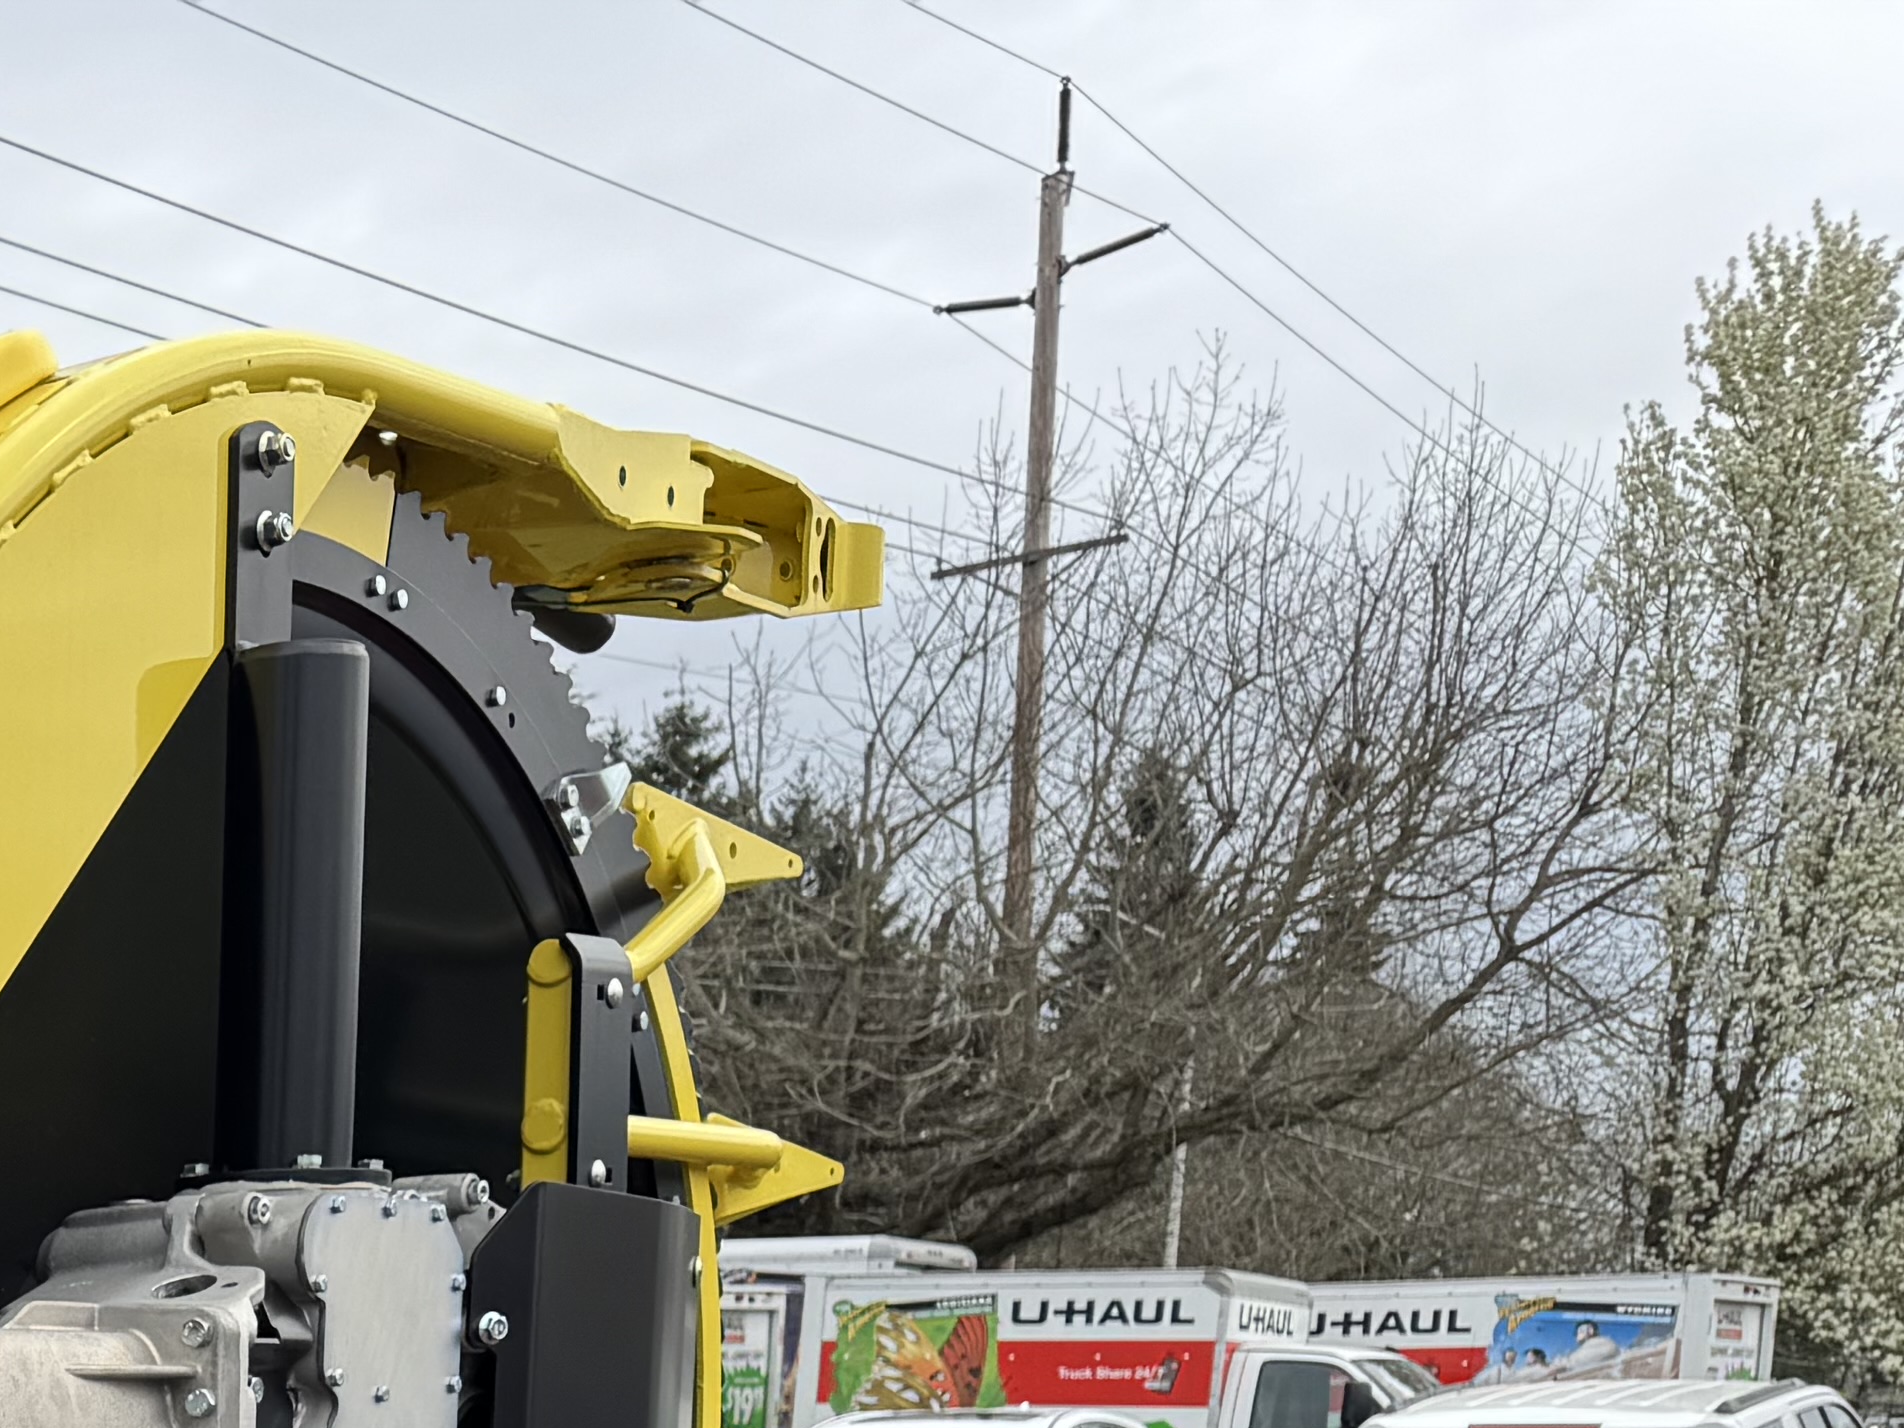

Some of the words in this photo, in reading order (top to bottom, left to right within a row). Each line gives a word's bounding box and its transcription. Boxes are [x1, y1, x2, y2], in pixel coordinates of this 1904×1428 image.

[1011, 1299, 1195, 1326] U-HAUL
[1239, 1303, 1293, 1336] U-HAUL
[1058, 1365, 1093, 1380] Truck
[1096, 1366, 1132, 1380] Share
